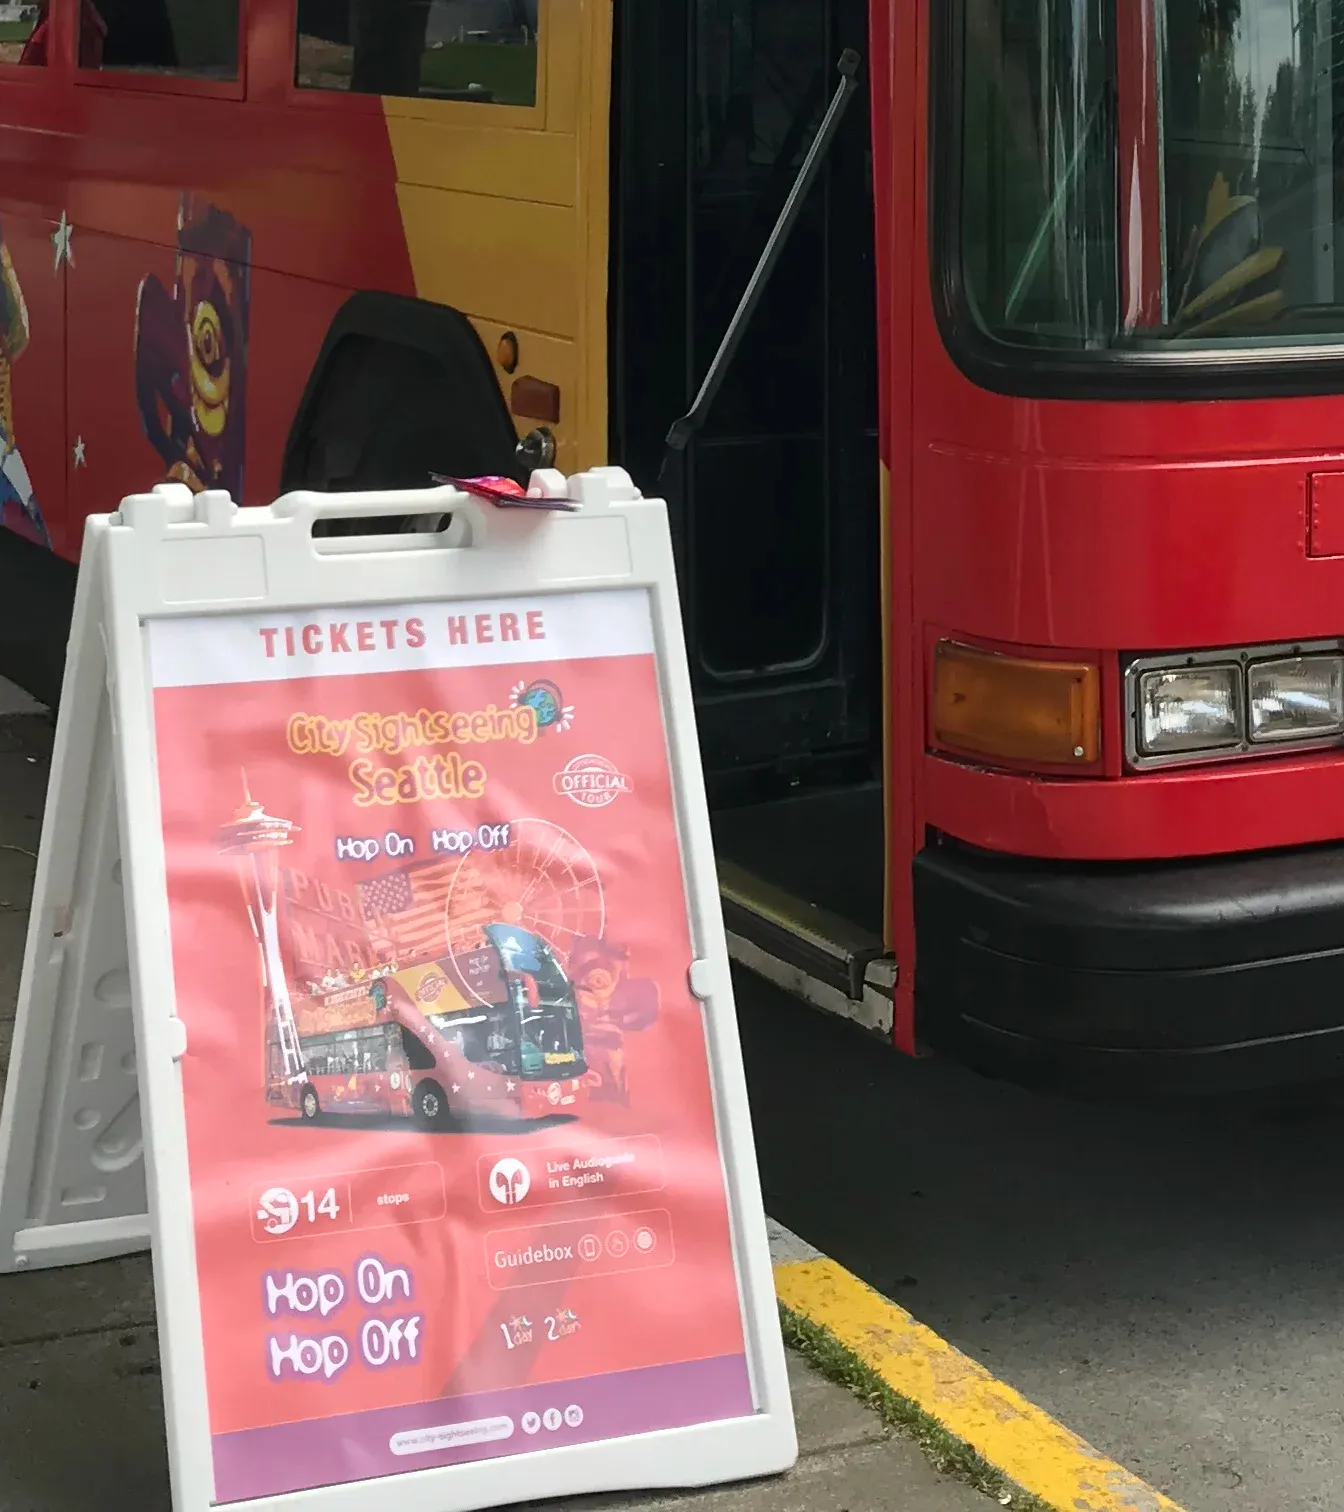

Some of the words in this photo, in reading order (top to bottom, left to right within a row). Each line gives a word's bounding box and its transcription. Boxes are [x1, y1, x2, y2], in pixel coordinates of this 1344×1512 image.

[259, 617, 427, 657] TICKETS
[448, 611, 547, 645] HERE
[348, 752, 487, 807] Seattle
[561, 774, 628, 791] OFFICIAL
[581, 792, 611, 804] TOUR
[336, 838, 379, 861] Hop
[385, 832, 413, 856] On
[432, 829, 473, 852] Hop
[478, 824, 510, 848] Off
[546, 1161, 570, 1174] Live
[548, 1177, 560, 1189] in
[562, 1172, 604, 1188] English
[301, 1187, 341, 1222] 14
[377, 1192, 410, 1205] stops
[494, 1244, 574, 1268] Guidebox
[267, 1273, 344, 1316] Hop
[358, 1258, 410, 1303] On
[544, 1316, 560, 1341] 2
[270, 1334, 349, 1378] Hop
[362, 1316, 420, 1365] Off
